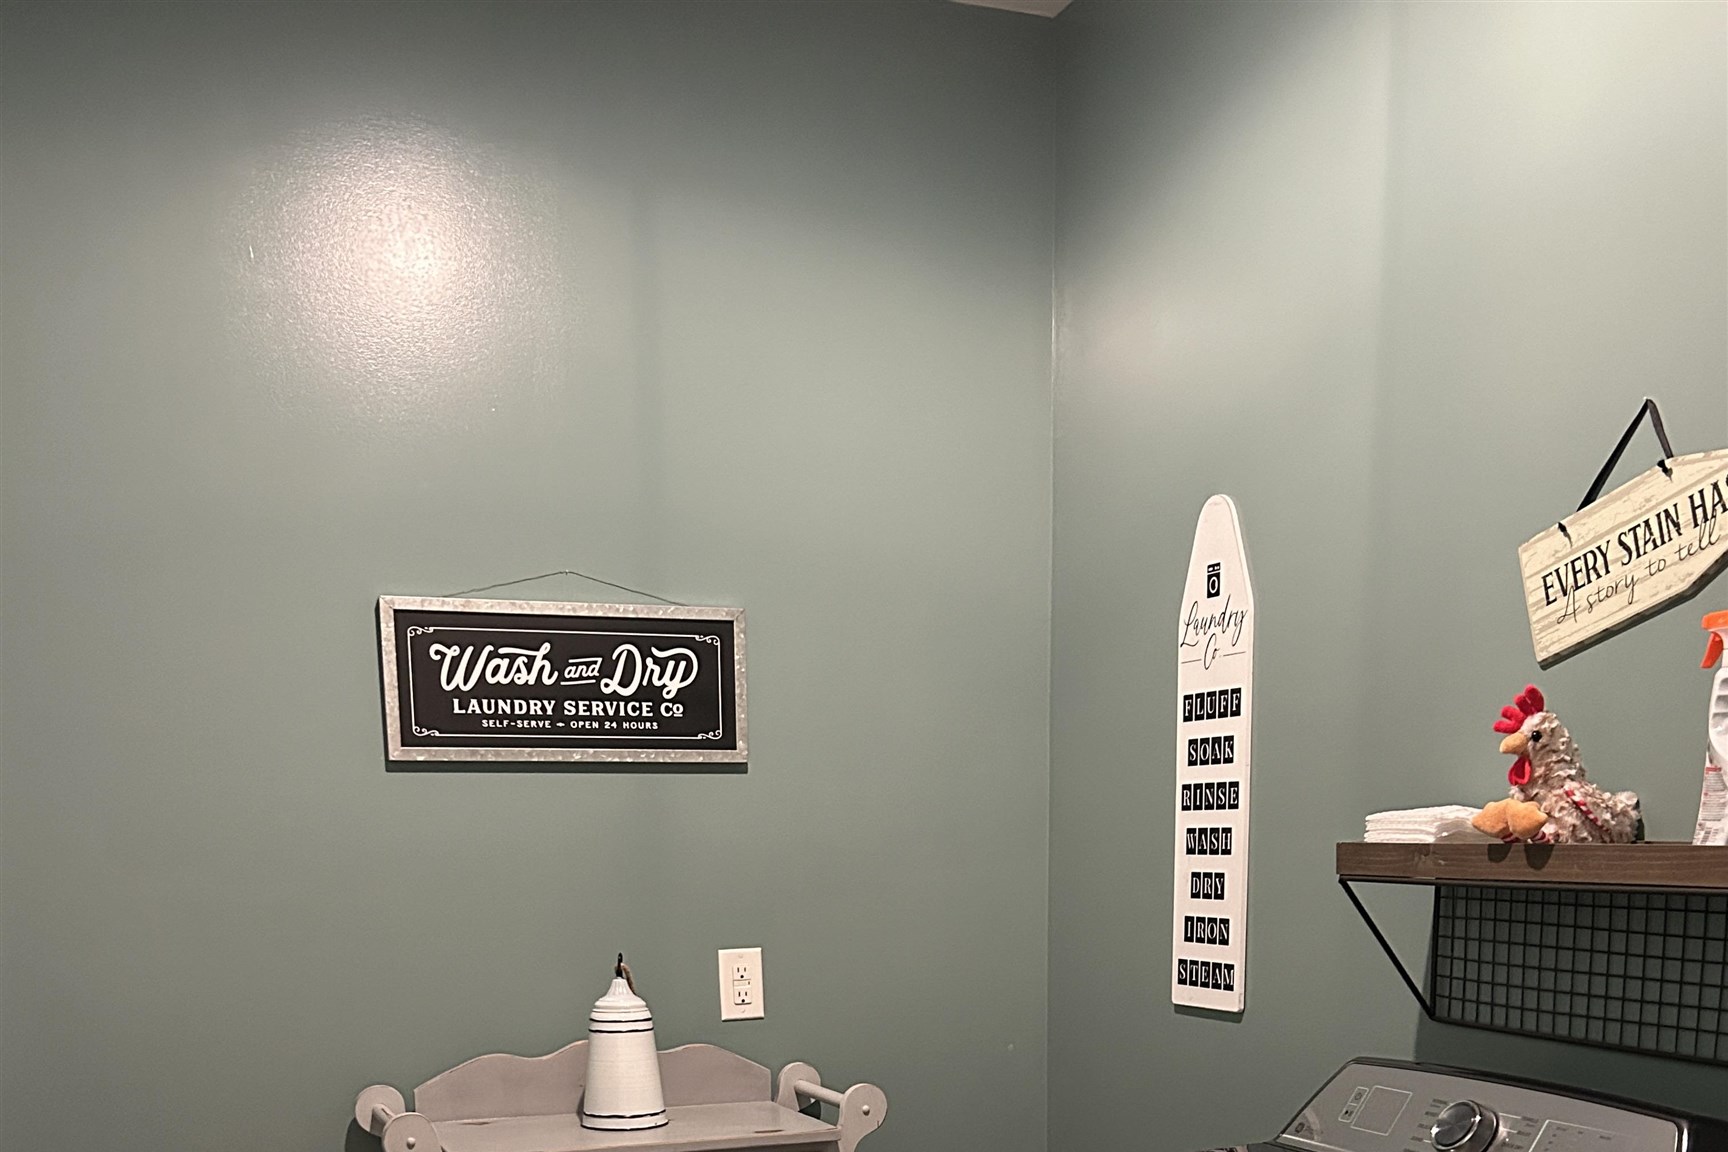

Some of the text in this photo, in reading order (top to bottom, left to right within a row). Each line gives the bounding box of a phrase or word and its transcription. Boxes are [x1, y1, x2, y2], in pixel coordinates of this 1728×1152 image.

[1541, 474, 1728, 607] EVERY STAIN HA
[1556, 509, 1721, 624] A story to tell
[1180, 594, 1248, 648] Laundry
[429, 642, 699, 700] Wash and Dry
[452, 698, 556, 715] LAUNDRY
[563, 700, 654, 717] SERVICE
[1184, 692, 1240, 717] FLUFF
[481, 719, 659, 730] SELF-SERVE OPEN 24 HOURS
[1189, 741, 1233, 761] SOAK
[1182, 787, 1238, 806] RINSE
[1186, 831, 1231, 850] WASH
[1192, 876, 1224, 895] DRY
[1186, 920, 1229, 941] IRON
[1178, 963, 1235, 986] STEAM
